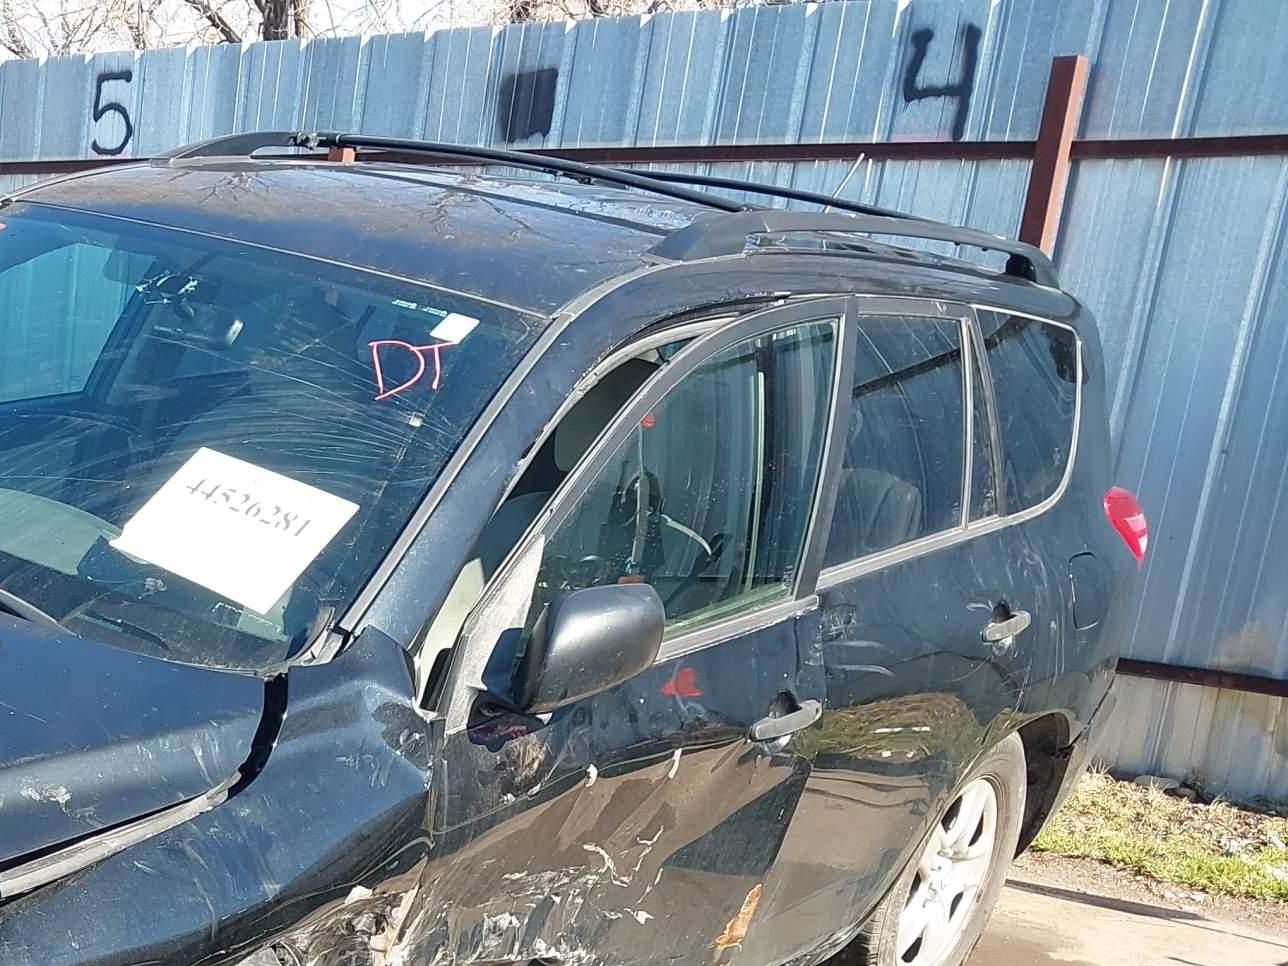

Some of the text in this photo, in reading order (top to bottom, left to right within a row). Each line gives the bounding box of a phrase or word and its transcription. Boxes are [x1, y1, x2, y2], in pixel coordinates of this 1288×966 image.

[91, 70, 132, 155] 5
[903, 22, 982, 140] 4
[368, 339, 459, 400] DT
[186, 478, 312, 537] 44526281
